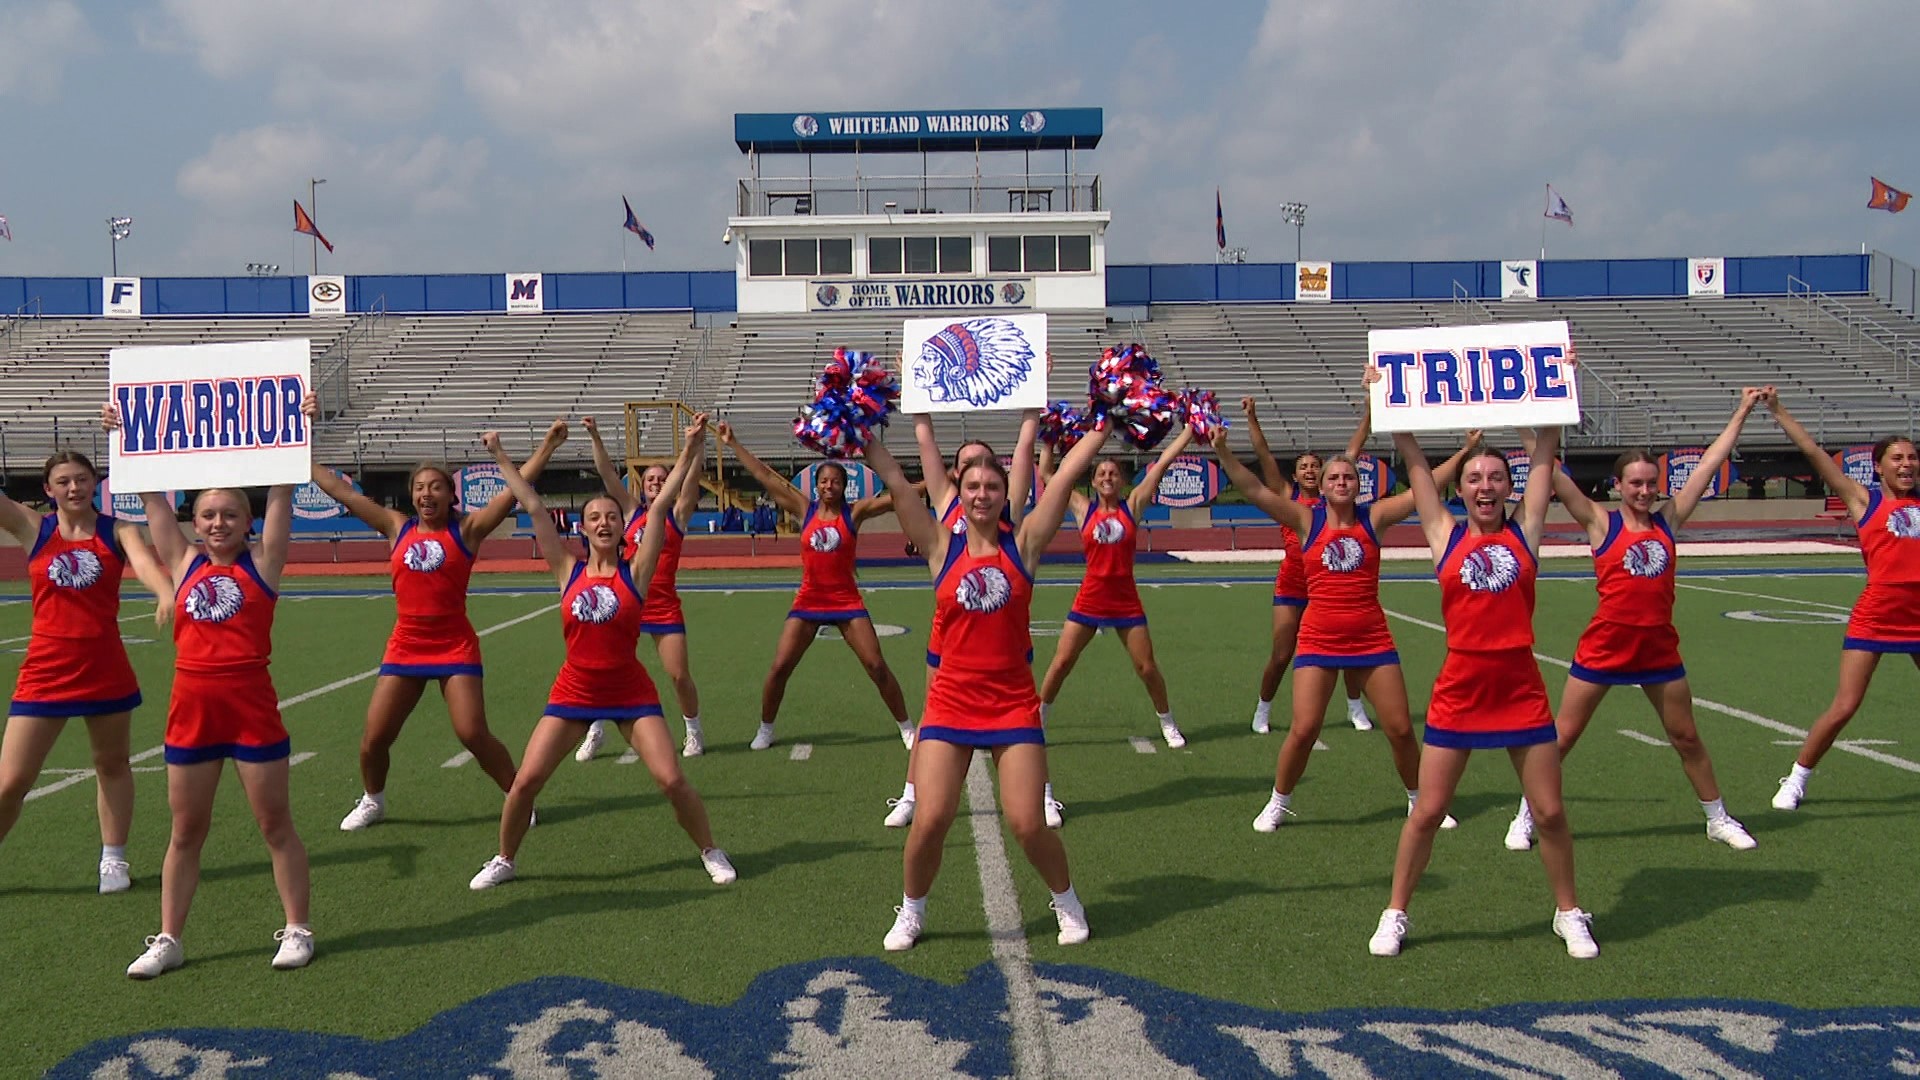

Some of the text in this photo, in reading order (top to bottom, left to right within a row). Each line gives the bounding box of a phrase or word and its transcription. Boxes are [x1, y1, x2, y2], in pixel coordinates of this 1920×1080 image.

[829, 115, 1010, 134] WHITELAND WARRIORS
[110, 283, 134, 304] F
[510, 279, 538, 300] M
[852, 285, 888, 295] HOME
[895, 284, 995, 306] WARRIORS
[849, 296, 891, 307] OF THE
[1374, 344, 1572, 407] TRIBE
[114, 375, 307, 457] WARRIOR
